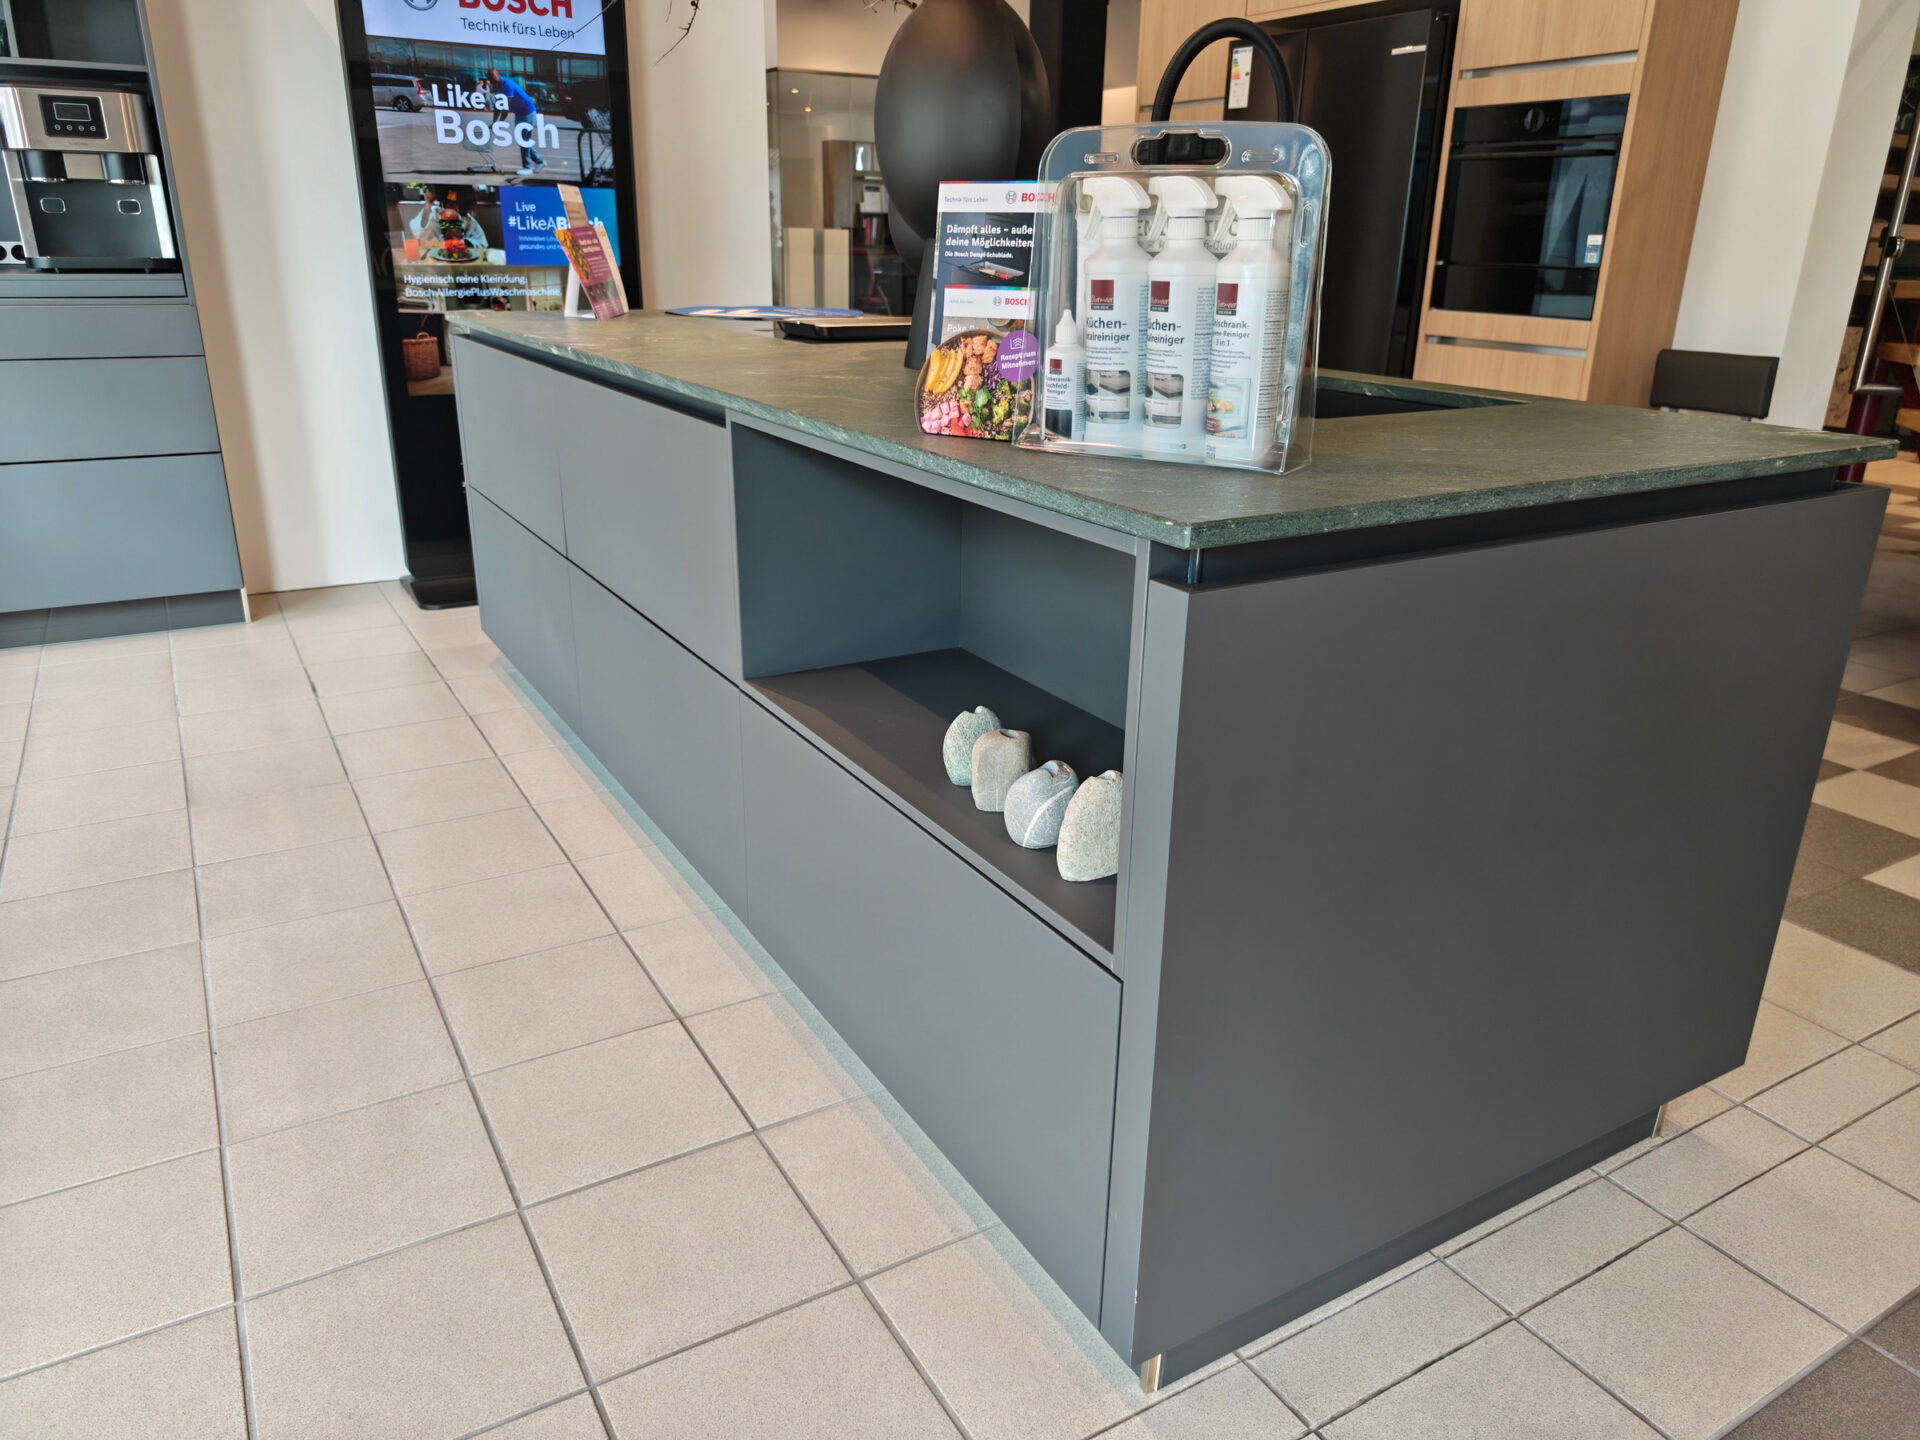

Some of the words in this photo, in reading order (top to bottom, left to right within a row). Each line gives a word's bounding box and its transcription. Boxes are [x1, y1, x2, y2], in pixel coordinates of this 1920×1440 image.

[460, 17, 510, 34] Technik
[512, 23, 537, 36] fürs
[539, 25, 575, 39] Leben
[431, 84, 486, 110] Like
[495, 92, 509, 111] a
[435, 109, 560, 149] Bosch
[515, 201, 536, 213] Live
[508, 215, 604, 231] #LikeABh
[946, 224, 978, 235] Dämpft
[980, 225, 1001, 235] alles
[945, 237, 970, 247] deine
[403, 274, 454, 287] Hygienisch
[405, 287, 435, 297] Bosch
